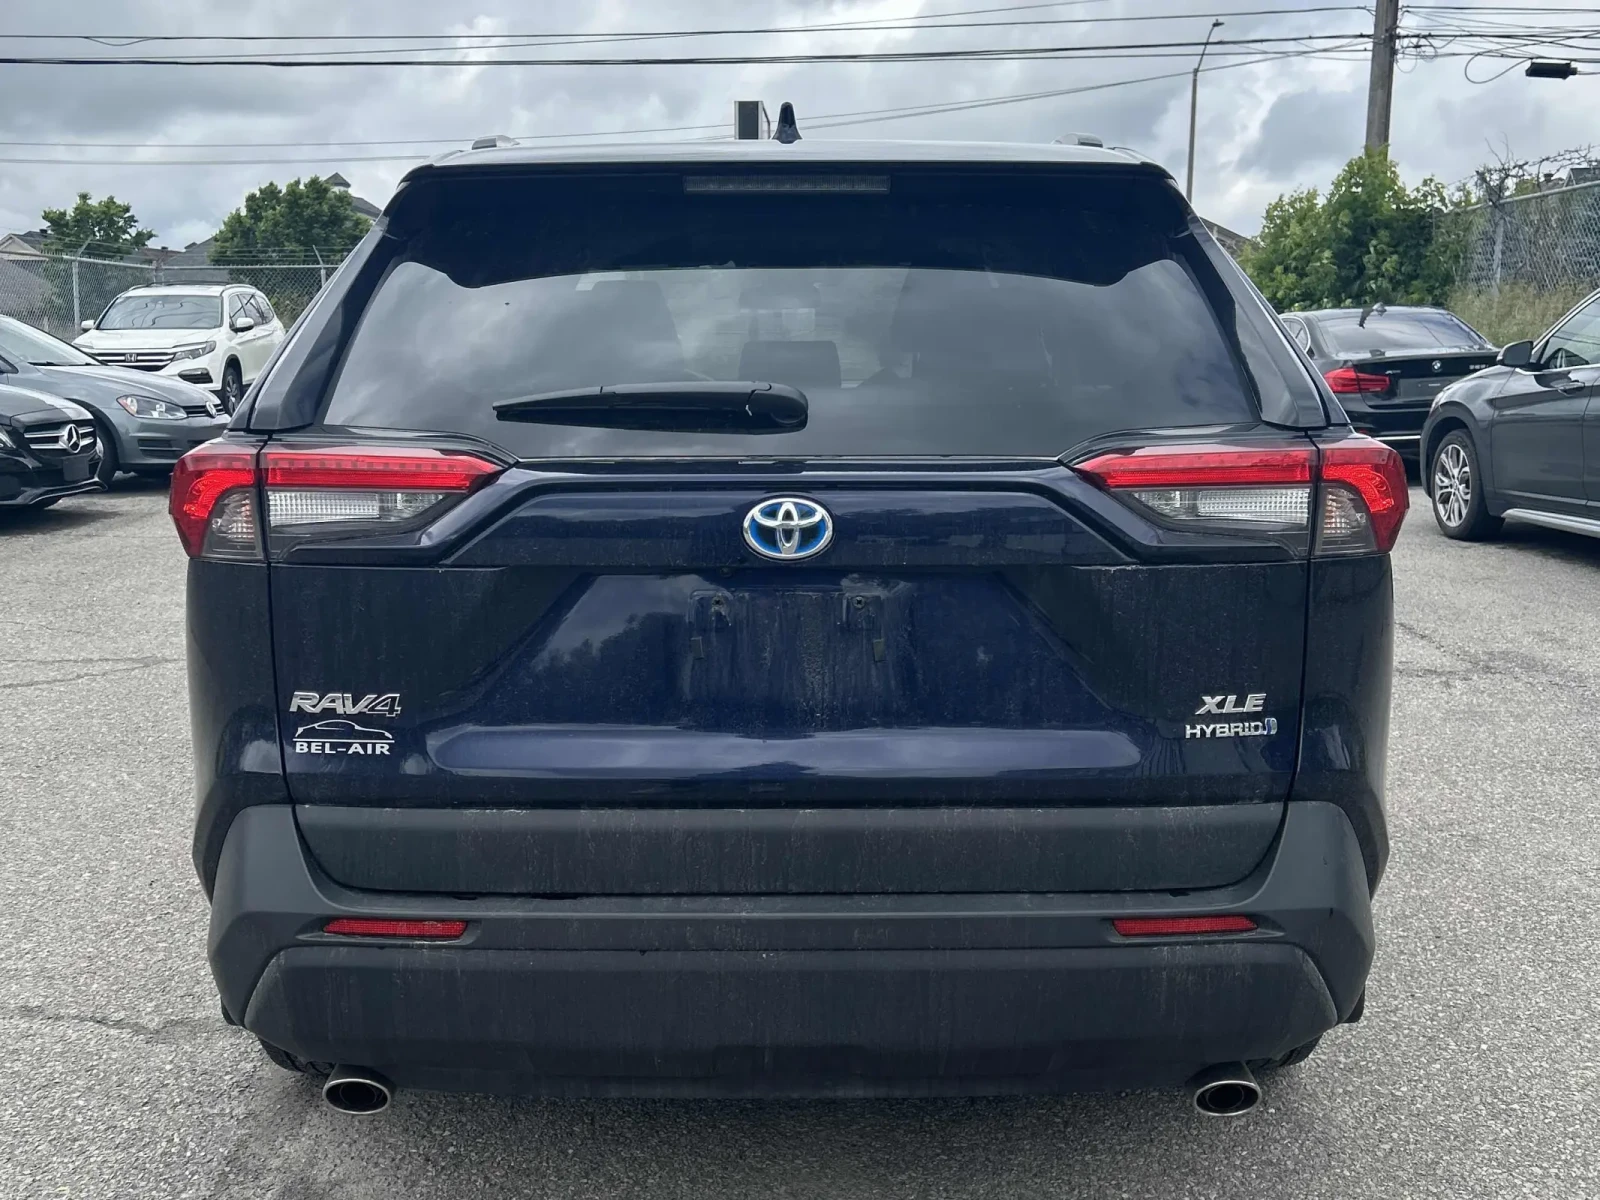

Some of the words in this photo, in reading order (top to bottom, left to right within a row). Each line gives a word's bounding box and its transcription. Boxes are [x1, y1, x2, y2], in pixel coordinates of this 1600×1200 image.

[289, 691, 402, 717] RAV4
[1194, 693, 1267, 715] XLE
[1185, 721, 1264, 739] HYBRID
[295, 741, 391, 755] BEL-AIR
